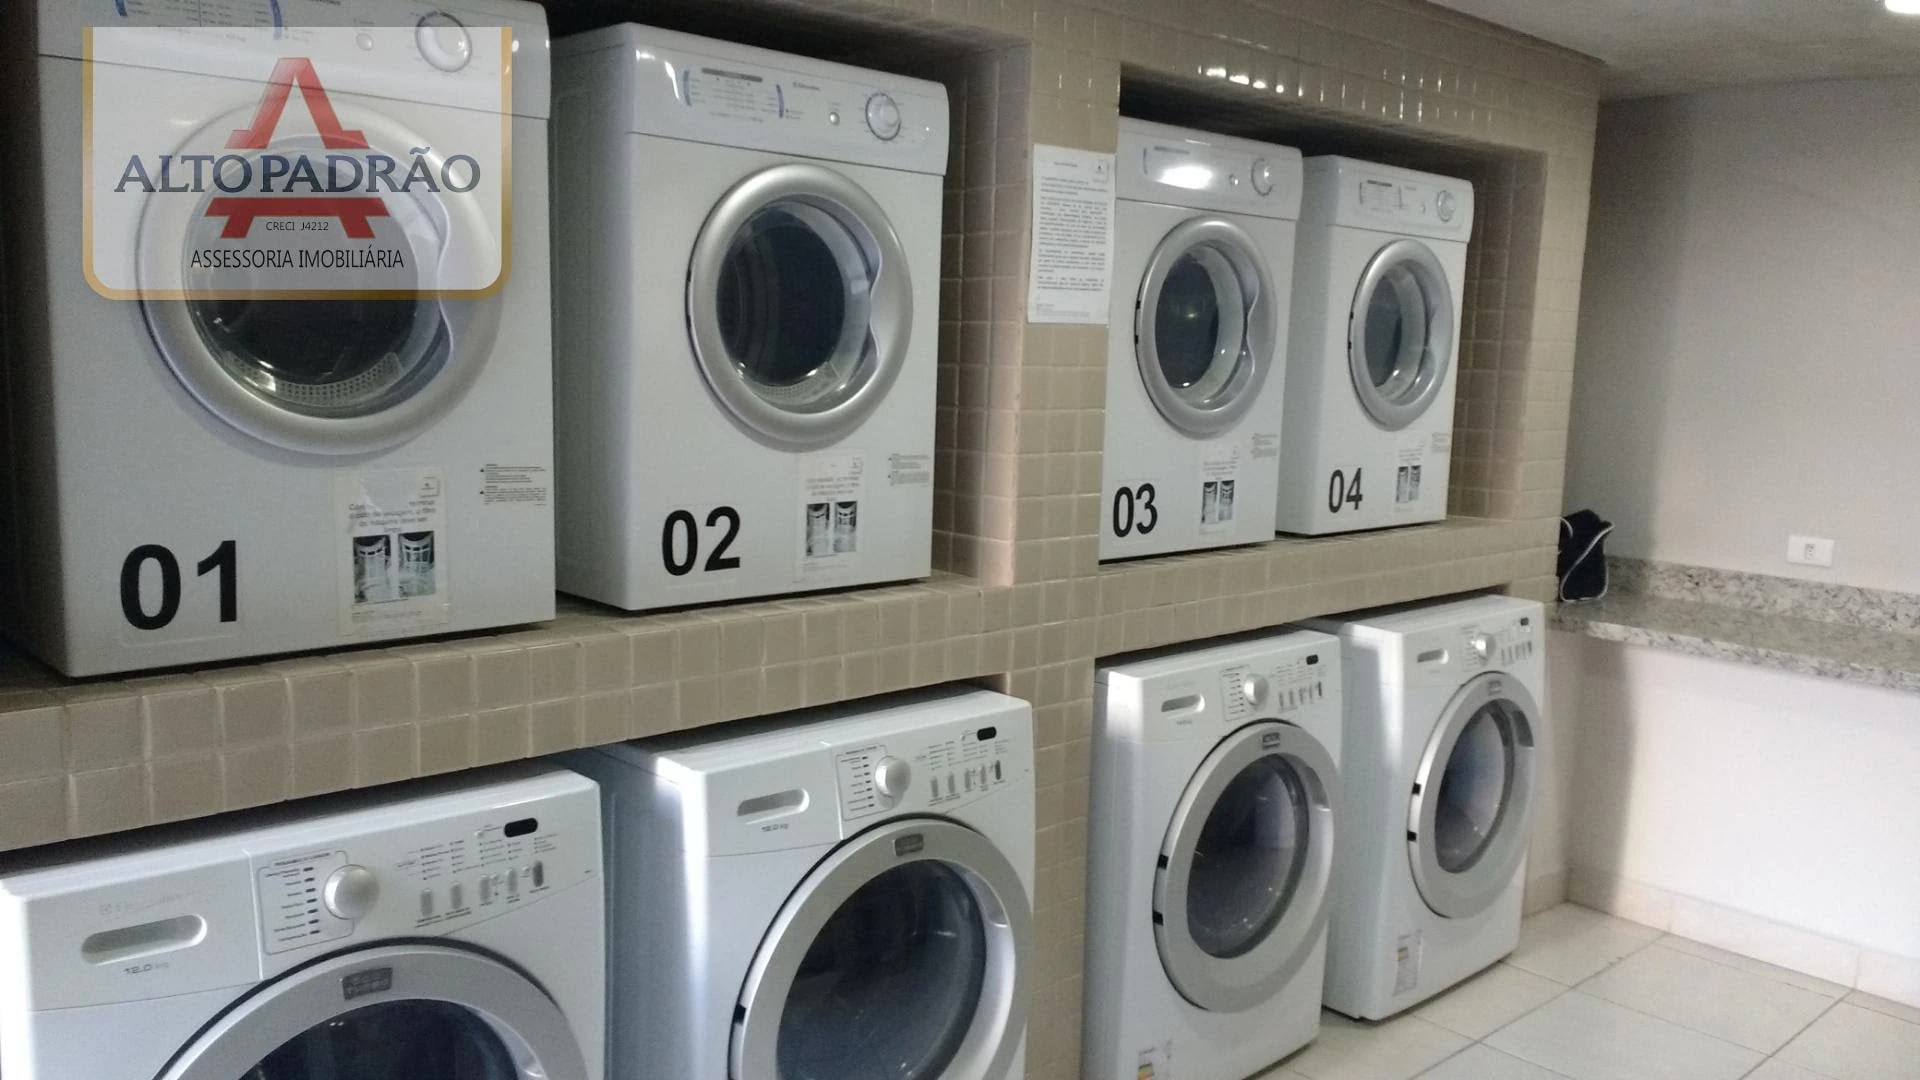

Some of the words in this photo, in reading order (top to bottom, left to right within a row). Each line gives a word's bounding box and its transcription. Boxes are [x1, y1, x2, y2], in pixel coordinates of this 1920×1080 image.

[1113, 483, 1158, 538] 03
[1328, 467, 1363, 513] 04
[662, 506, 741, 576] 02
[120, 540, 237, 630] 01
